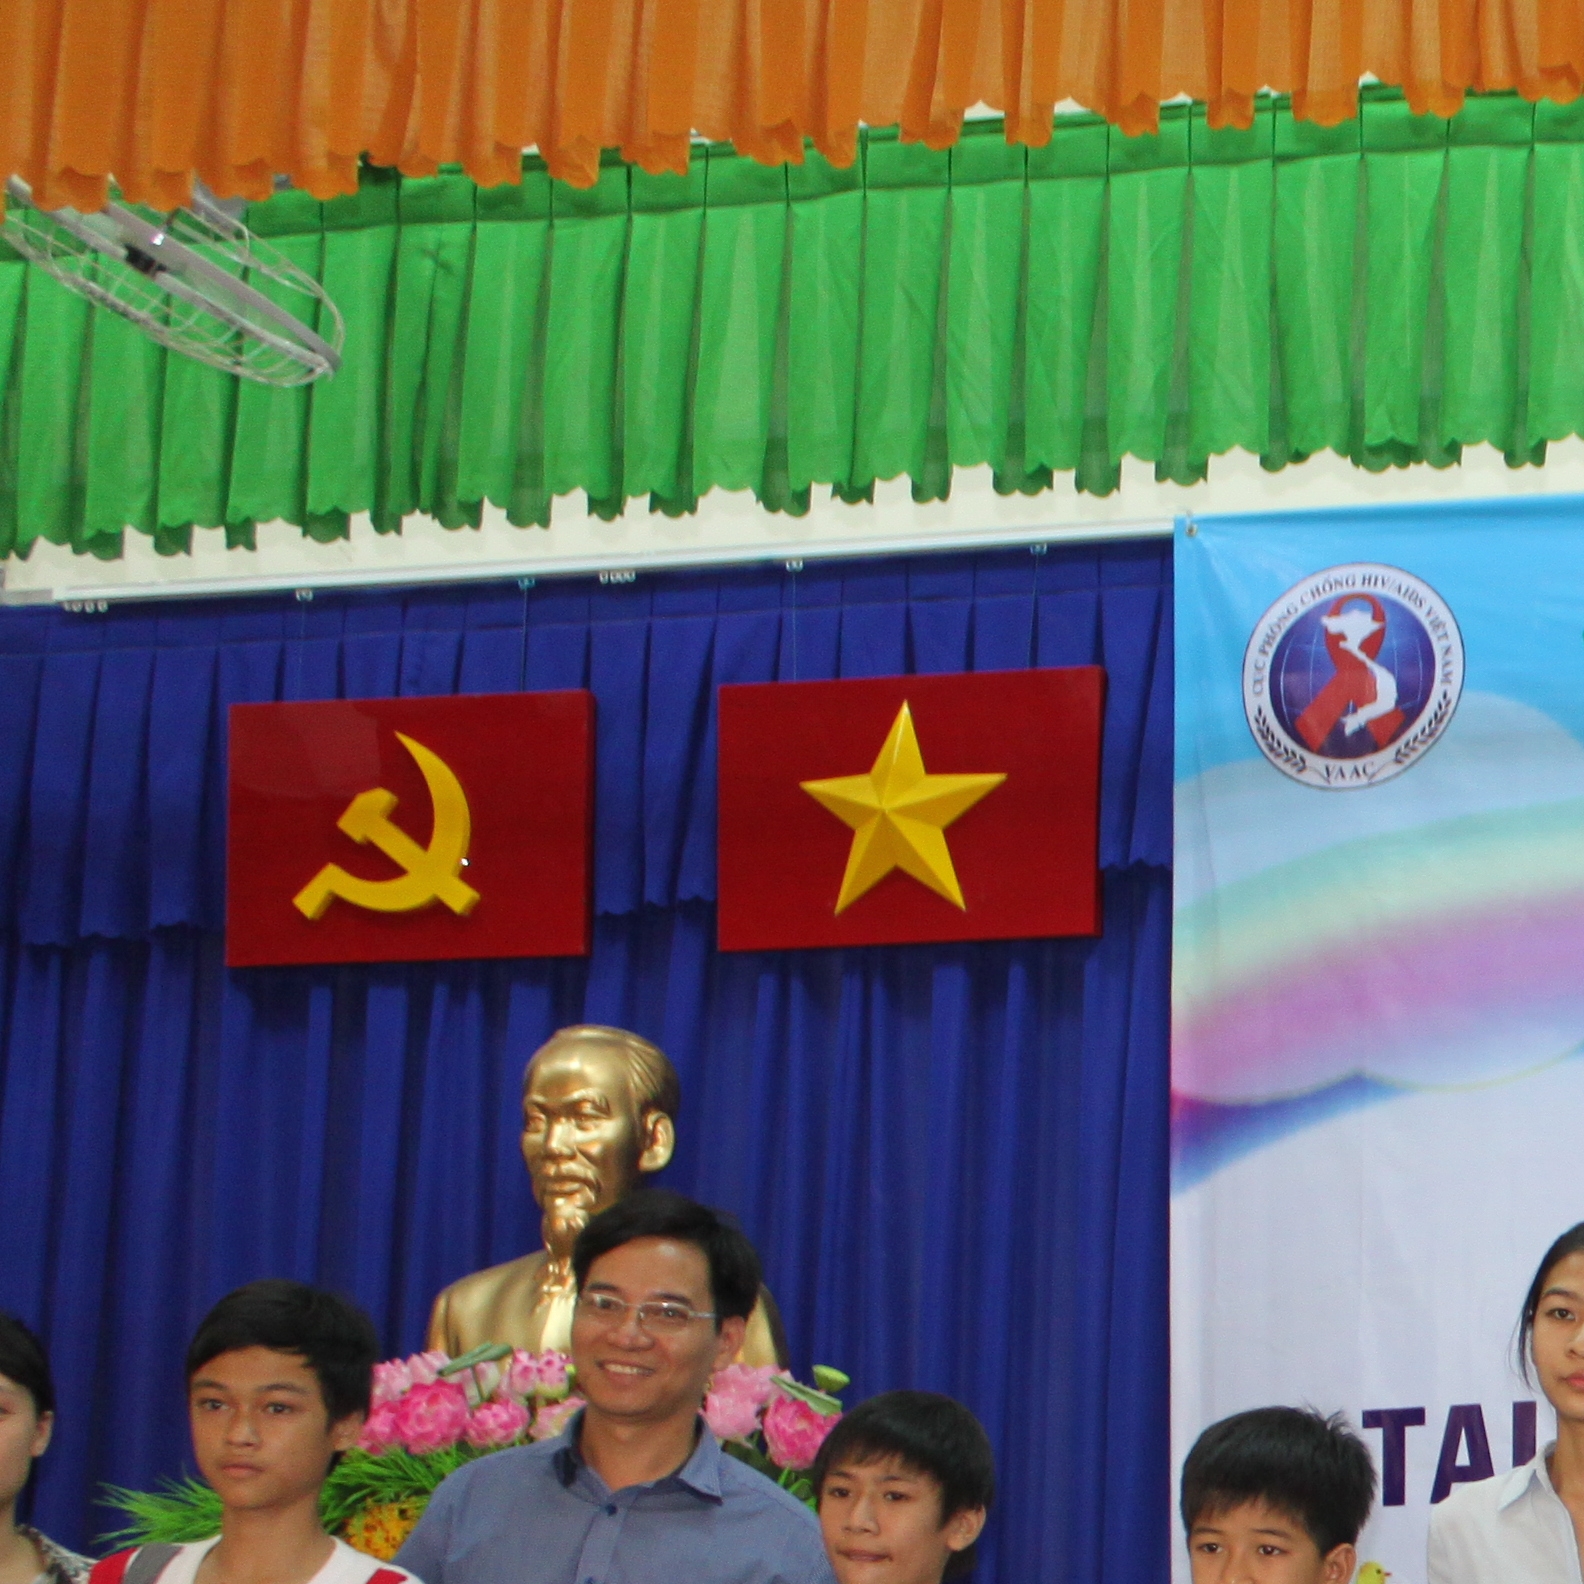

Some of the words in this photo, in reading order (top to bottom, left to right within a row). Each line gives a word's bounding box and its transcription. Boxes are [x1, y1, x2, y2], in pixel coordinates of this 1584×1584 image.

[1300, 572, 1358, 606] CHỐNG
[1361, 572, 1427, 609] HIV/AIDS
[1441, 645, 1454, 687] NAM
